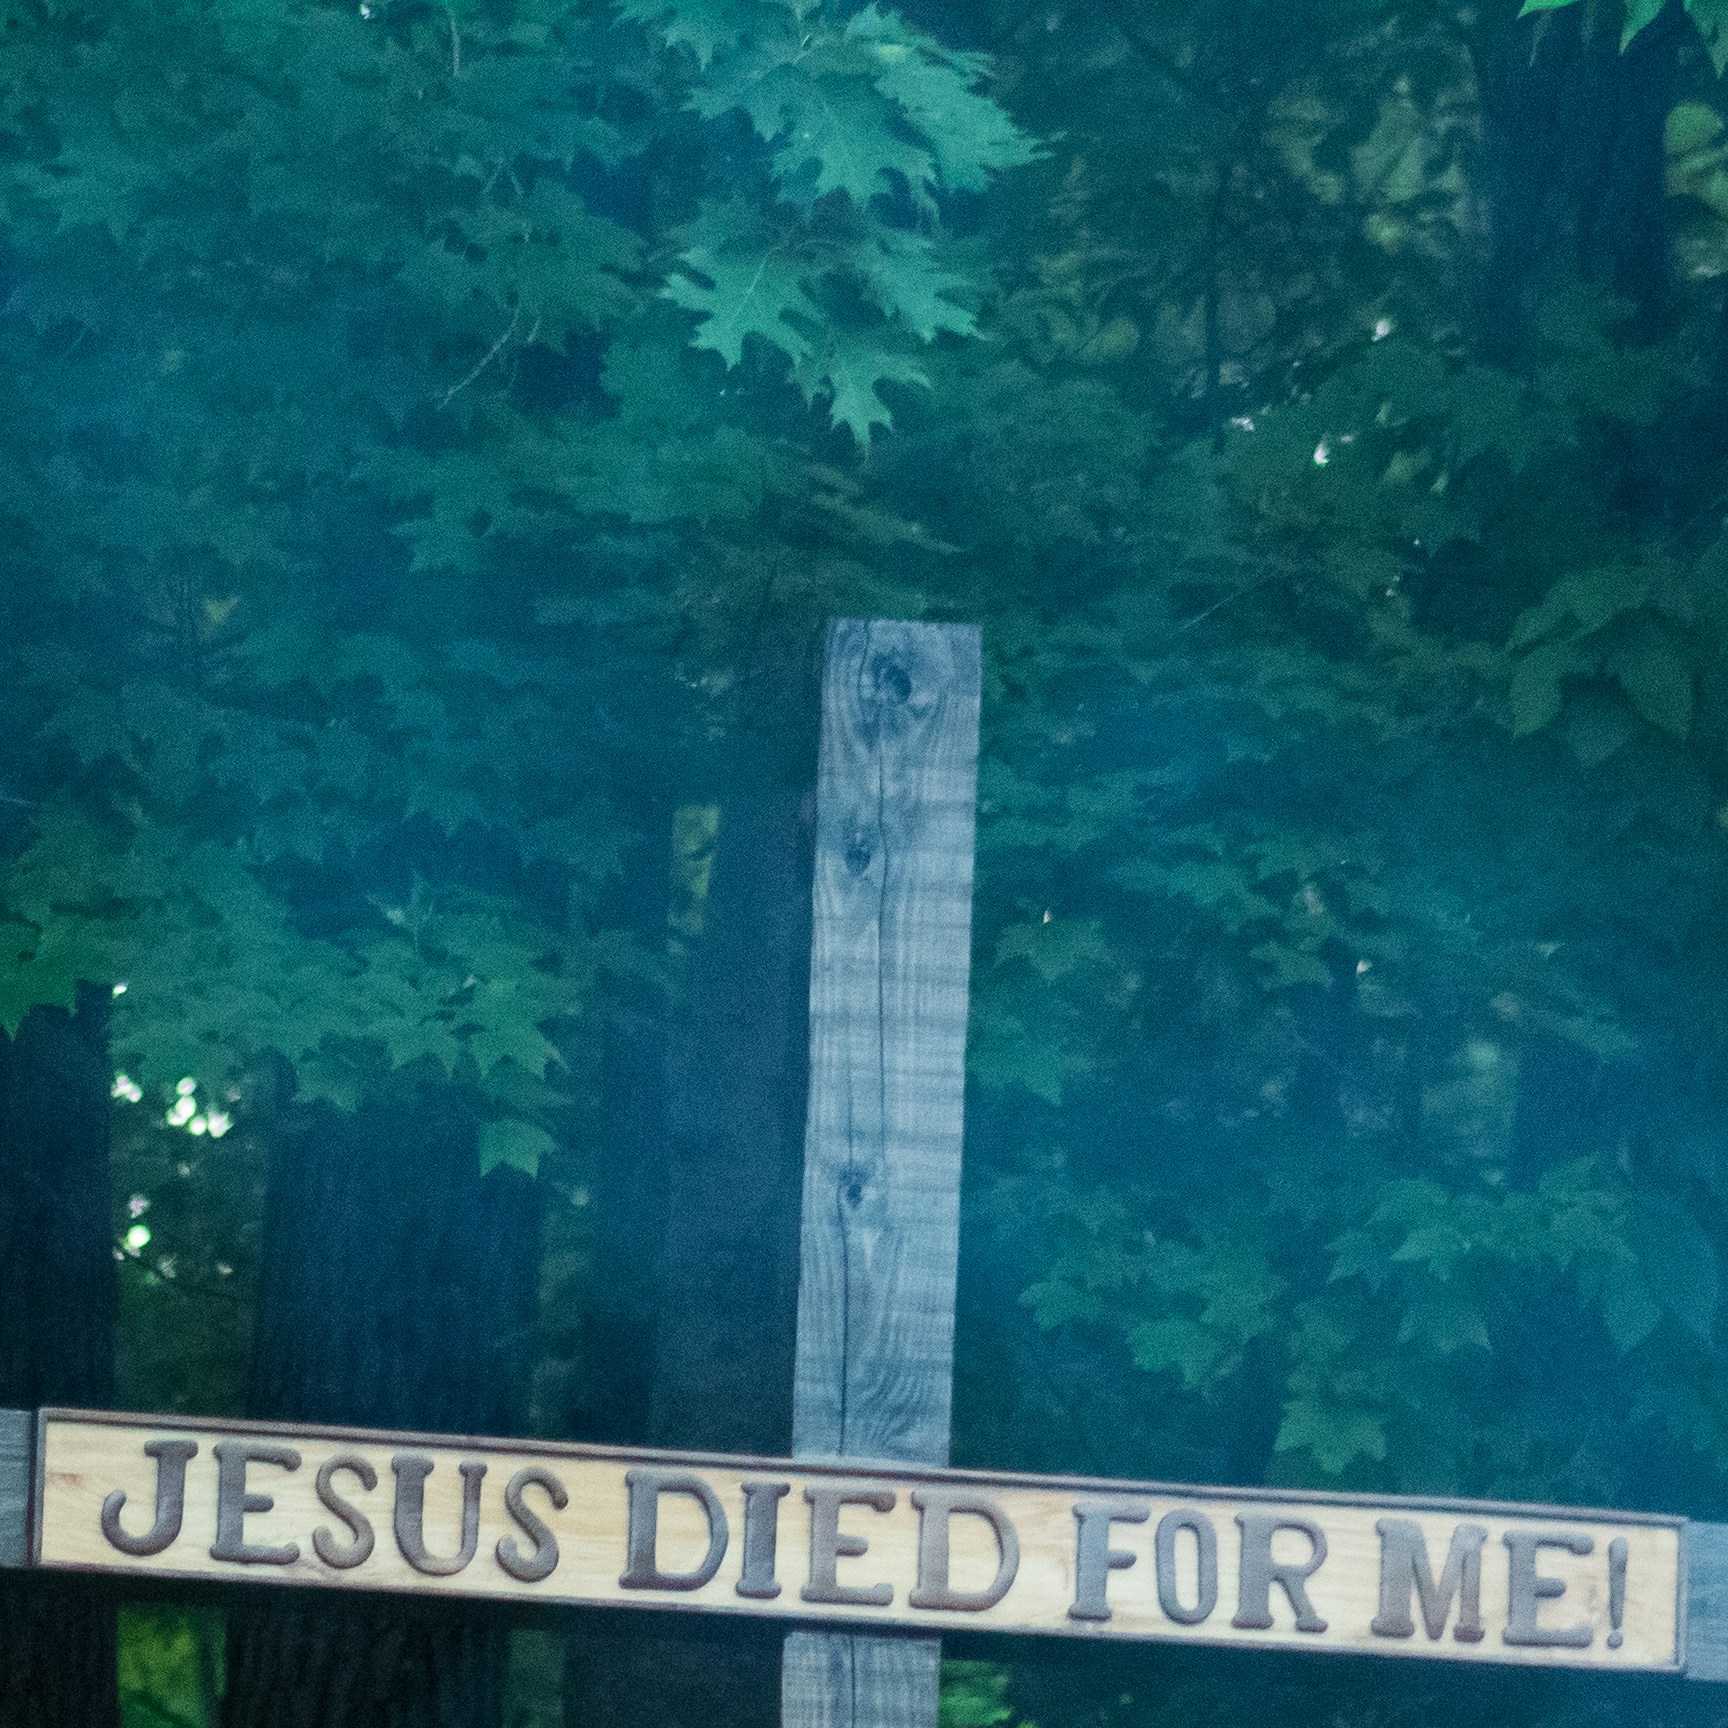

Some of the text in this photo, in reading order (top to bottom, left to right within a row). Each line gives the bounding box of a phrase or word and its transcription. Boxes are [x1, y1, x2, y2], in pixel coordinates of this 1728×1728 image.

[100, 1439, 1629, 1650] JESUS DIED FOR ME!
